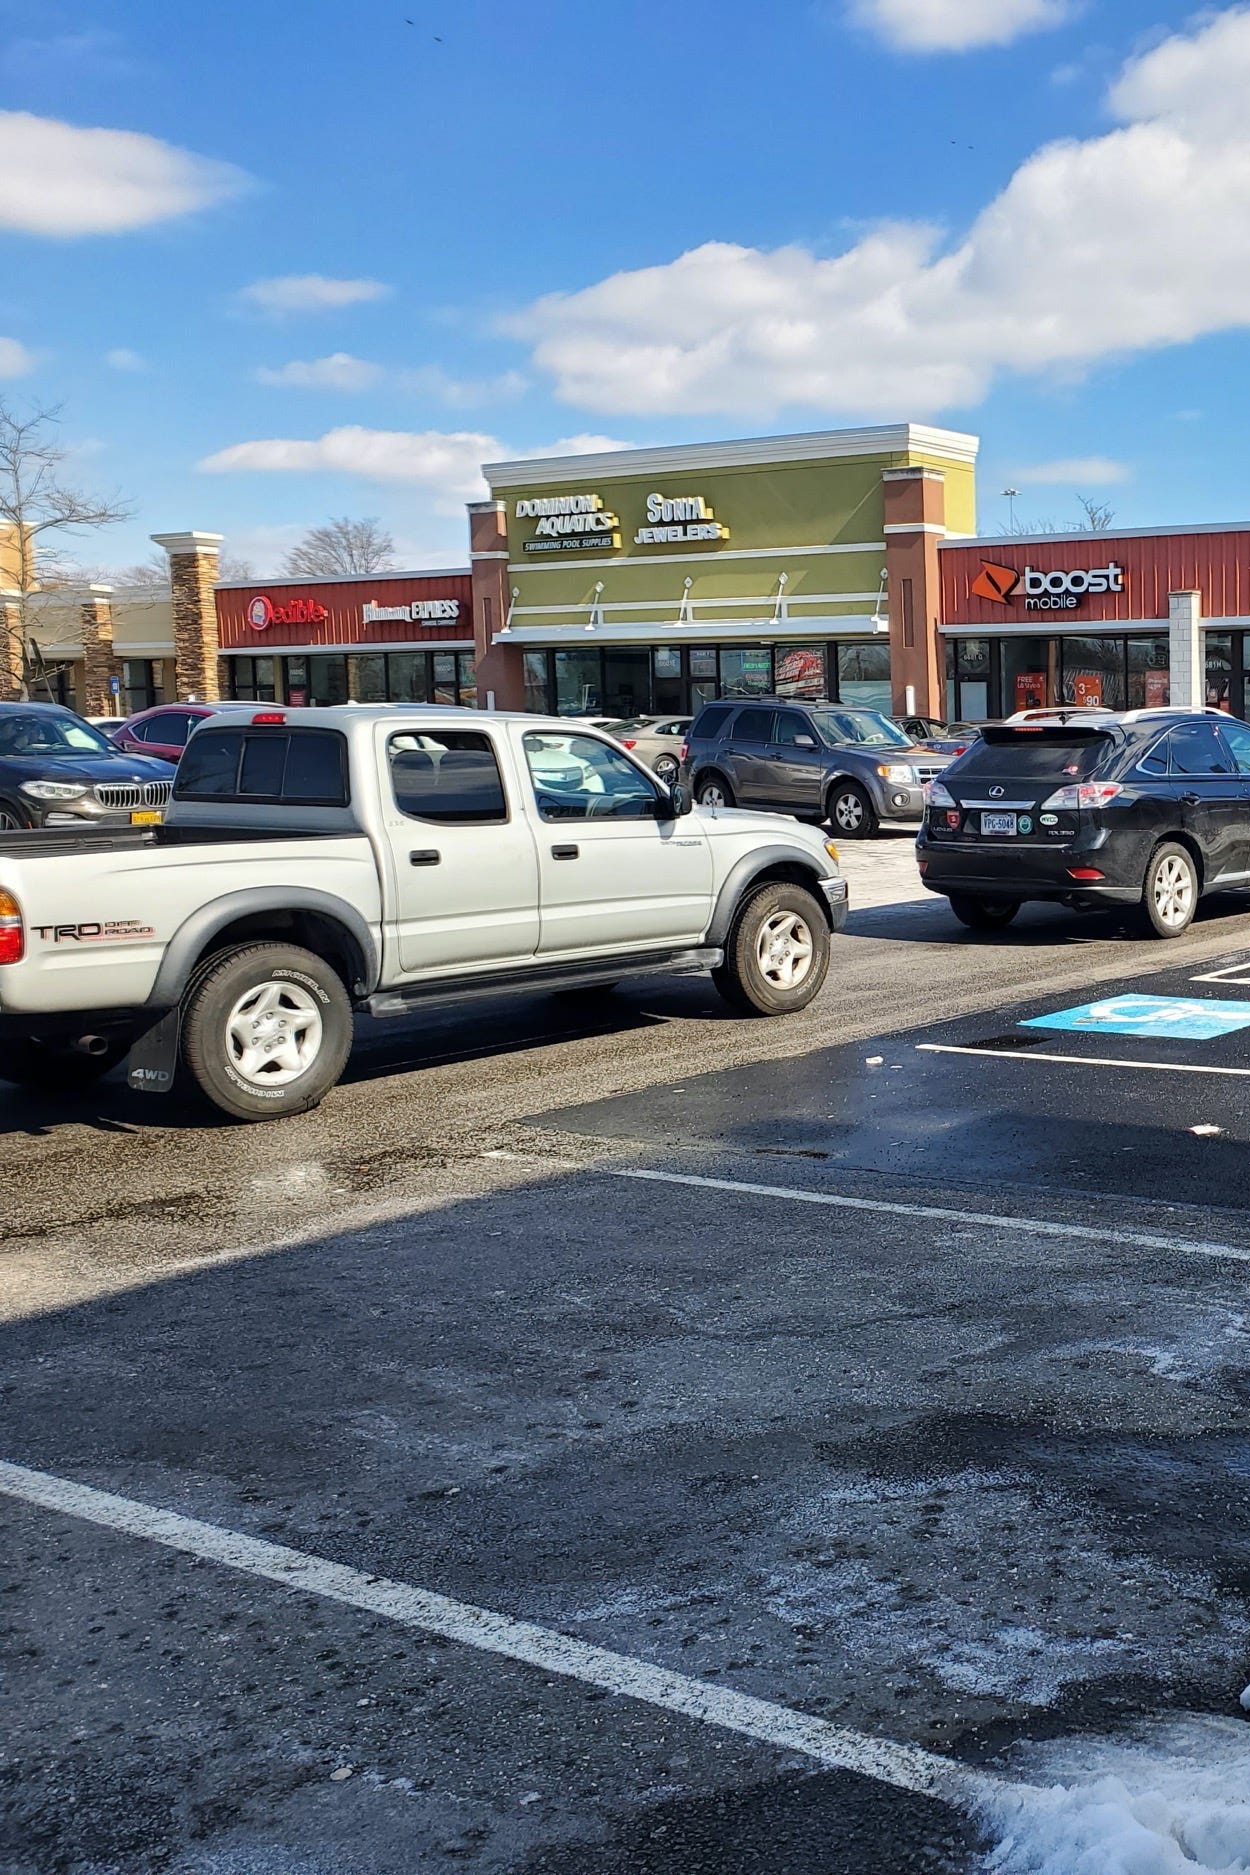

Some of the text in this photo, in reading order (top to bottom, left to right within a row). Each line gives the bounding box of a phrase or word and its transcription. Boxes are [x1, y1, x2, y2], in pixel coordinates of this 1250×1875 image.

[516, 494, 601, 517] DOMINION
[646, 493, 710, 523] SONIA
[535, 512, 615, 537] AQUATICS
[634, 523, 726, 544] JEWELERS
[525, 537, 611, 551] SWIMMING POOL SUPPLIES
[1025, 562, 1122, 594] boost
[271, 600, 325, 624] edible
[411, 600, 459, 619] EXPRESS
[1025, 595, 1077, 610] mobile
[1078, 683, 1086, 695] 3
[1083, 695, 1100, 707] $90
[983, 818, 1014, 829] VPG-5048
[30, 922, 102, 943] TRD
[104, 926, 153, 936] ROAD
[272, 969, 330, 1004] MICHELIN
[131, 1068, 170, 1081] 4WD
